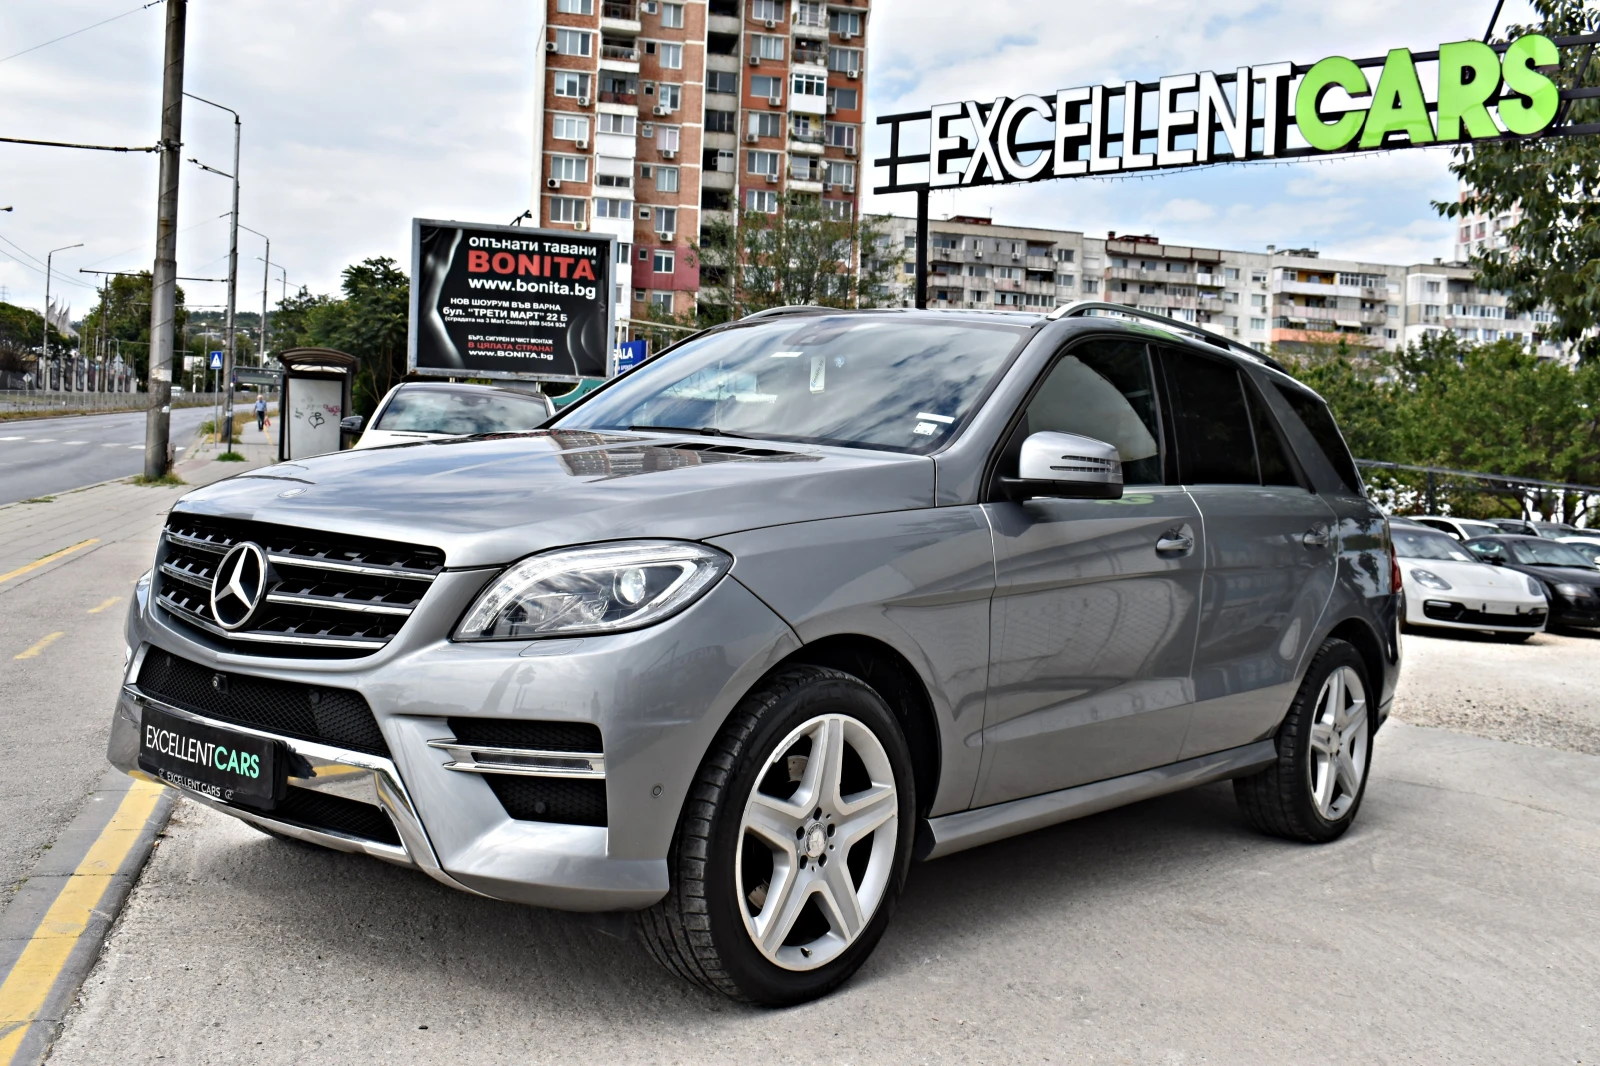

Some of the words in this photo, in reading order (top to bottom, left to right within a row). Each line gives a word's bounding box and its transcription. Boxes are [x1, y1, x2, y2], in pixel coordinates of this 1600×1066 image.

[469, 236, 539, 252] опънати
[543, 241, 597, 256] тавани
[468, 249, 596, 281] BONITA
[468, 278, 597, 299] www.bonita.bg
[450, 297, 470, 305] НОВ
[471, 299, 510, 308] ШОУРУМ
[511, 301, 532, 309] ВЪВ
[532, 303, 562, 311] ВАРНА
[442, 306, 466, 317] бул.
[546, 313, 558, 321] 22
[560, 314, 568, 322] Б
[468, 350, 554, 361] www.BONITA.bg
[477, 342, 514, 350] ЦЯЛАТА
[515, 344, 554, 352] СТРАНА!
[166, 771, 201, 792] EXCELLENT
[201, 783, 221, 798] CARS
